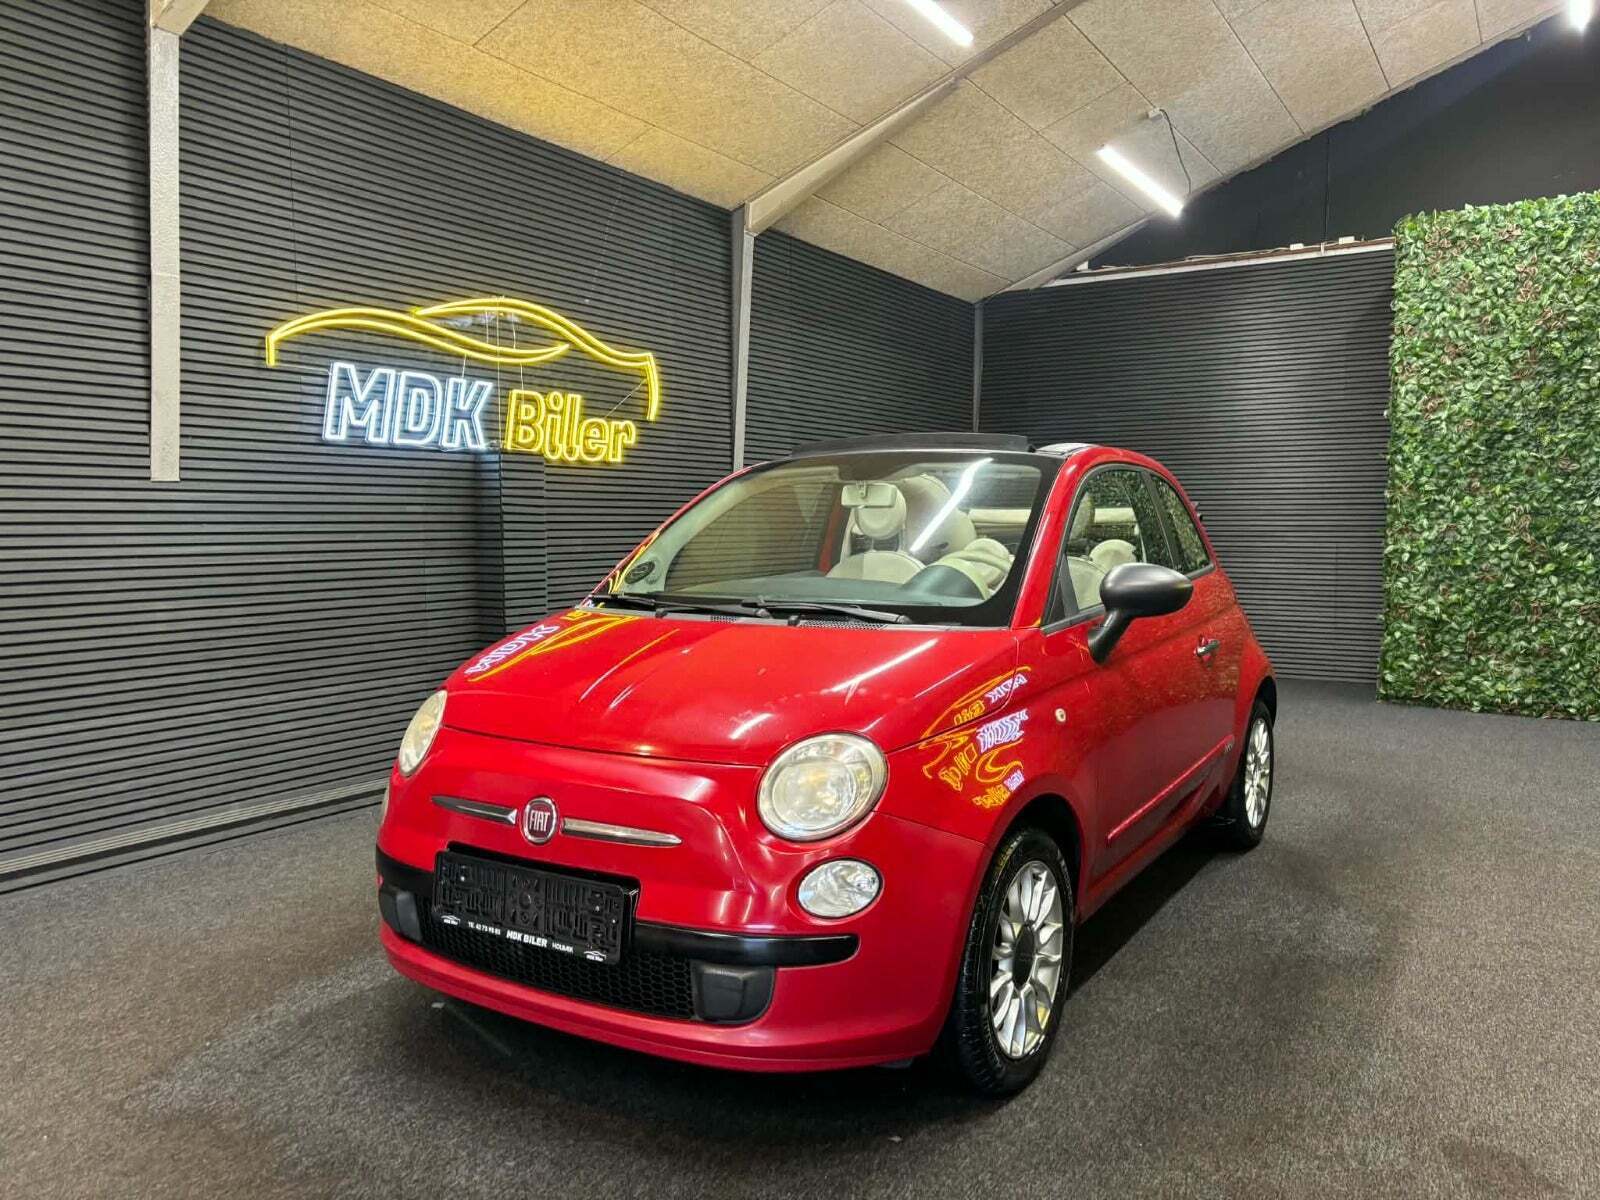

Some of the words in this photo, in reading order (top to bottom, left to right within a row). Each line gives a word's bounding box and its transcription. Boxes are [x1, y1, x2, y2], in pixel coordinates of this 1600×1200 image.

[322, 361, 493, 449] MDK
[505, 388, 637, 463] Biler
[529, 810, 551, 832] FIAT
[507, 930, 523, 942] MDK
[523, 934, 548, 948] BILER
